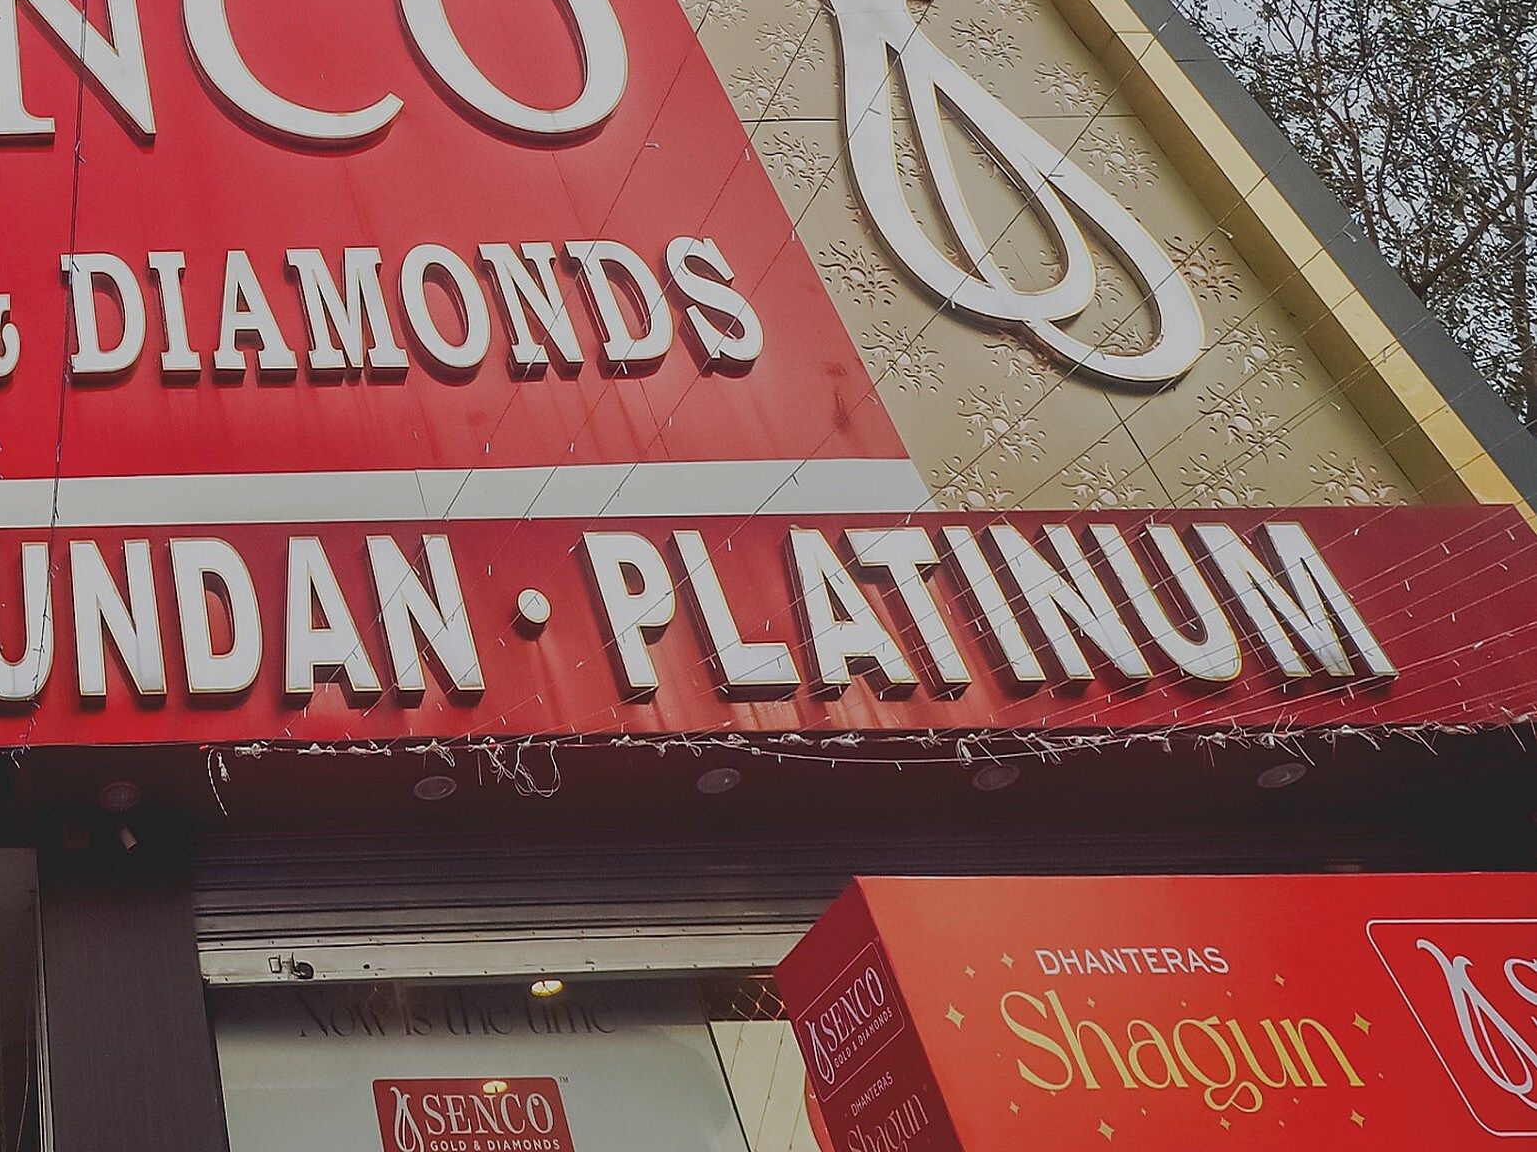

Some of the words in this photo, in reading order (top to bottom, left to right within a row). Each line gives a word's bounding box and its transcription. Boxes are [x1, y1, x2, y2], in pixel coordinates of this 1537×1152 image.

[62, 237, 764, 378] DIAMONDS
[581, 521, 1400, 698] PLATINUM
[1035, 947, 1230, 975] DHANTERAS
[820, 966, 884, 1052] SENCO
[834, 1048, 851, 1068] GOLD
[859, 1006, 893, 1046] DIAMONDS
[1000, 990, 1365, 1113] Shagun
[423, 1092, 555, 1135] SENCO
[850, 1071, 894, 1117] DHANTERAS
[430, 1140, 467, 1152] GOLD
[473, 1140, 481, 1151] &
[487, 1139, 561, 1151] DIAMONDS
